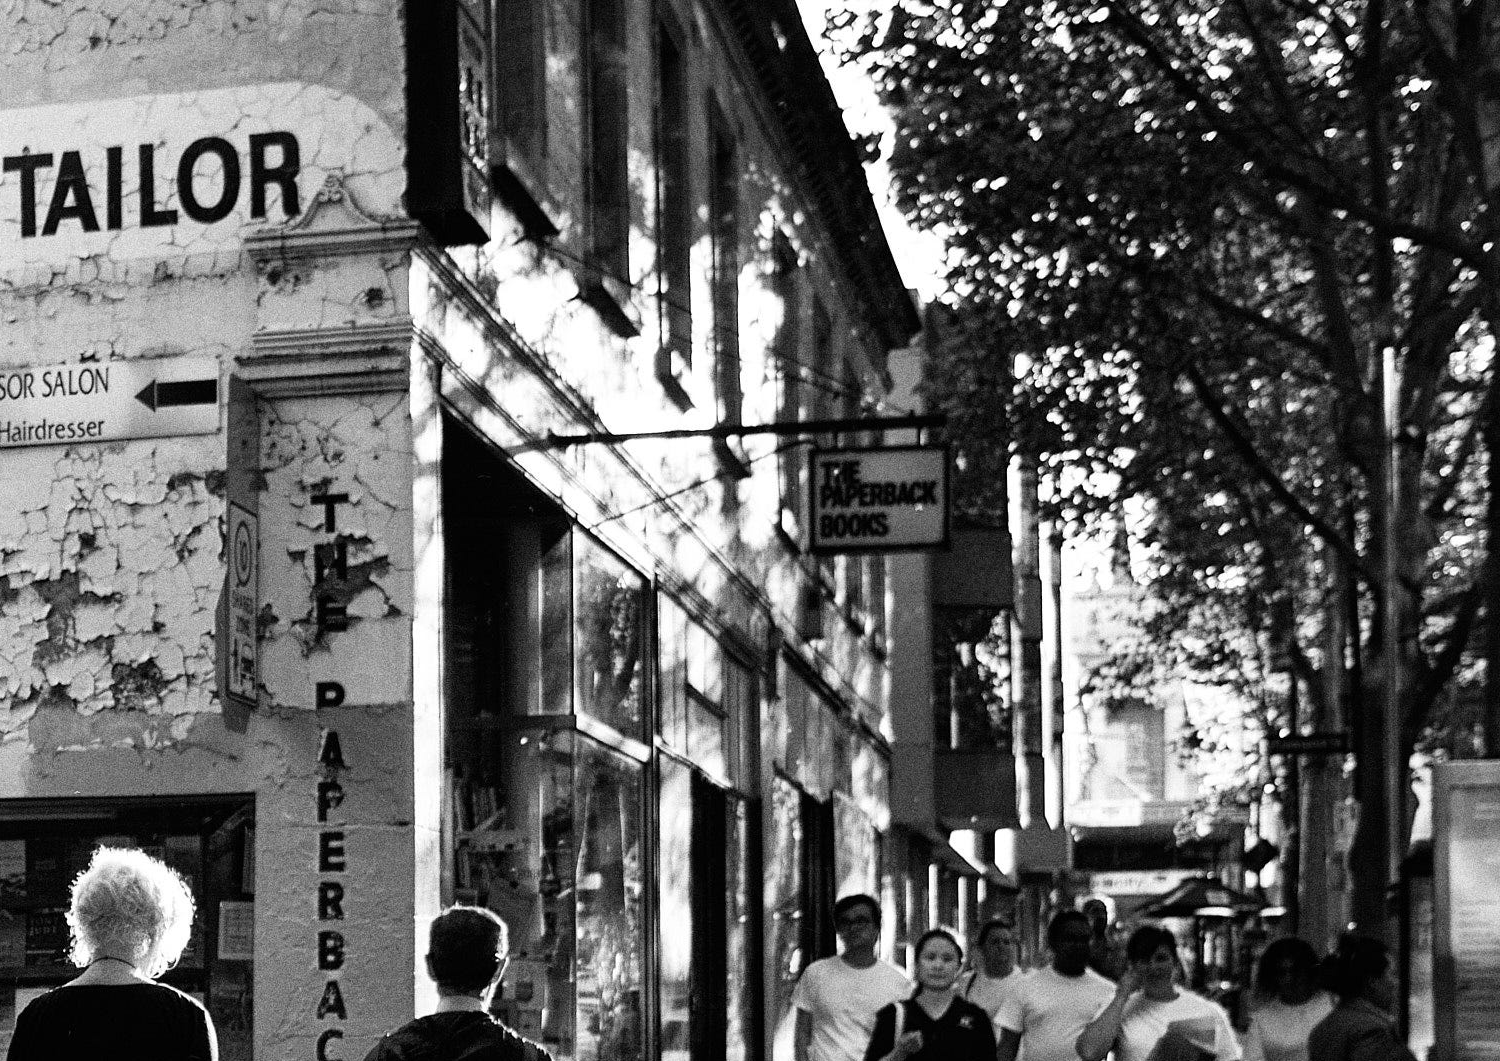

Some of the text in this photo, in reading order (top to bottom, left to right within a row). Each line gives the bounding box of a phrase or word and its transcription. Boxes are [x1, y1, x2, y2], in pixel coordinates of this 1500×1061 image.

[41, 367, 110, 399] SALON
[820, 480, 938, 509] PAPERBACK
[820, 512, 890, 539] BOOKS
